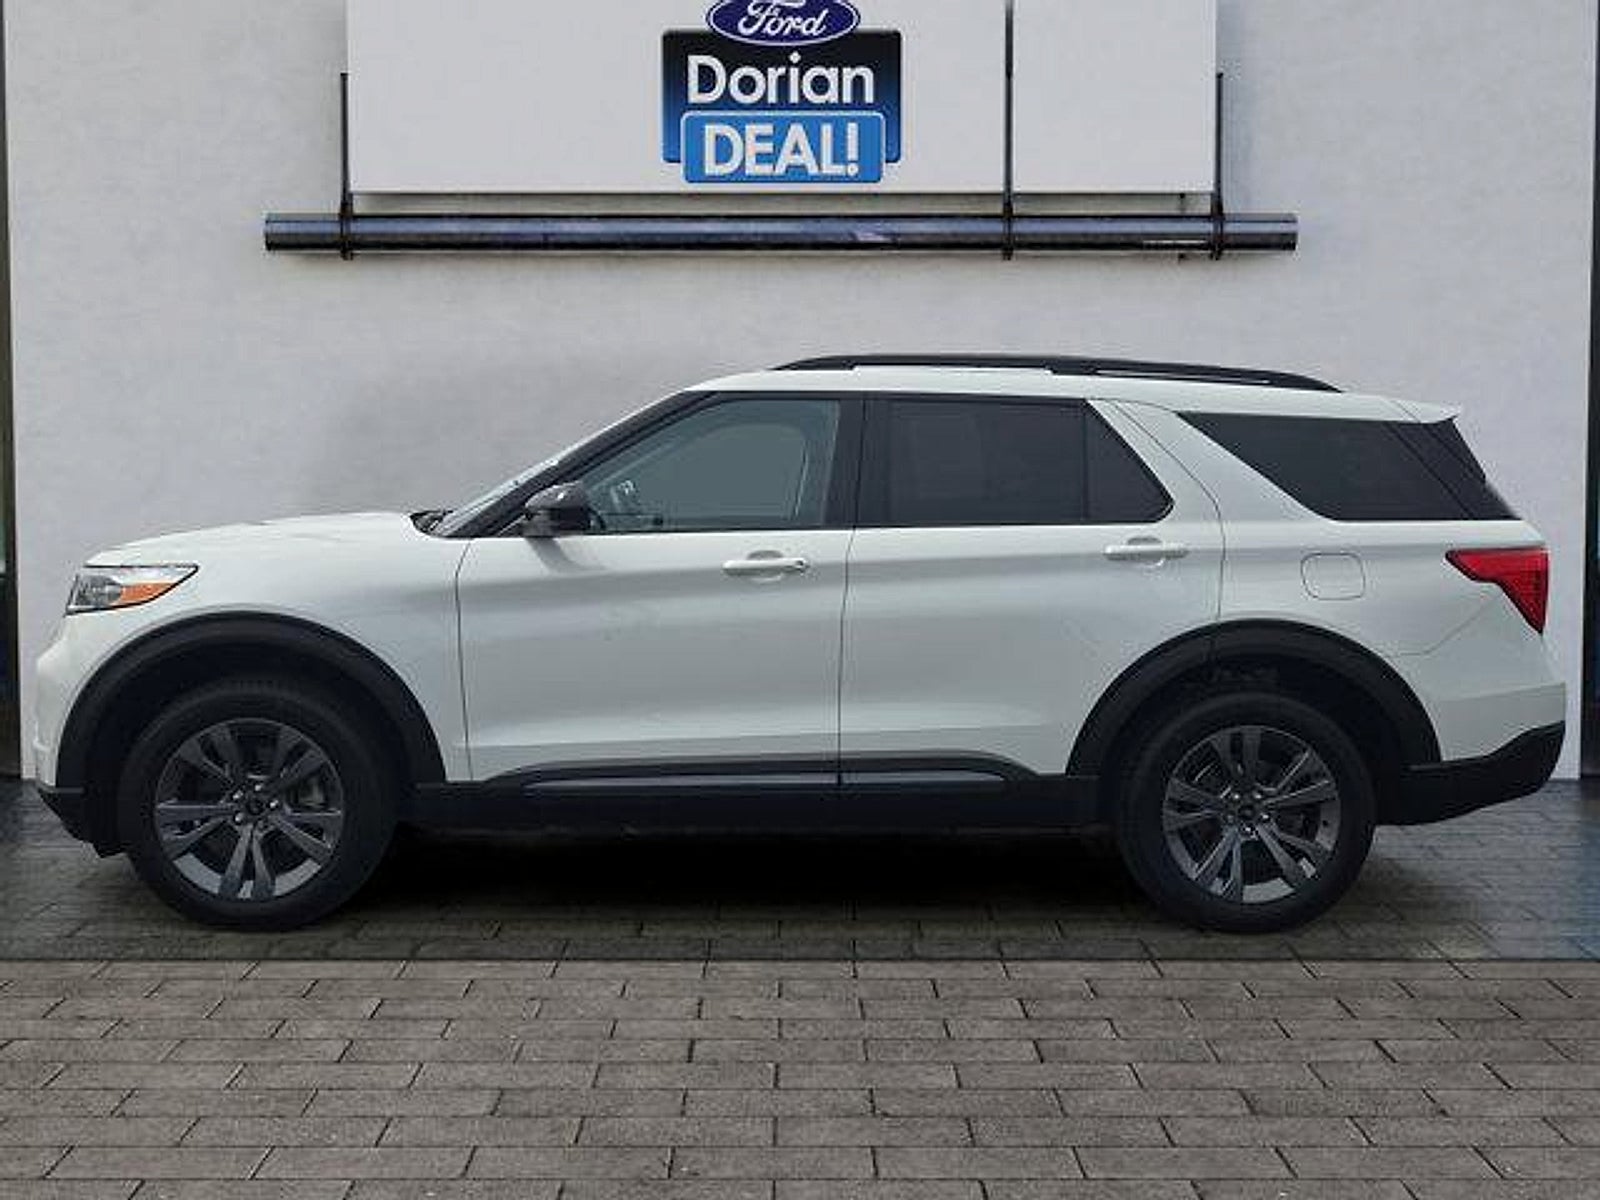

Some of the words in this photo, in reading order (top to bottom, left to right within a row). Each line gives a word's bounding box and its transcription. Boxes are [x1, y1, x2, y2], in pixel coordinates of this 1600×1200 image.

[737, 0, 829, 36] Ford
[687, 51, 875, 104] Dorian
[704, 122, 860, 177] DEAL!
